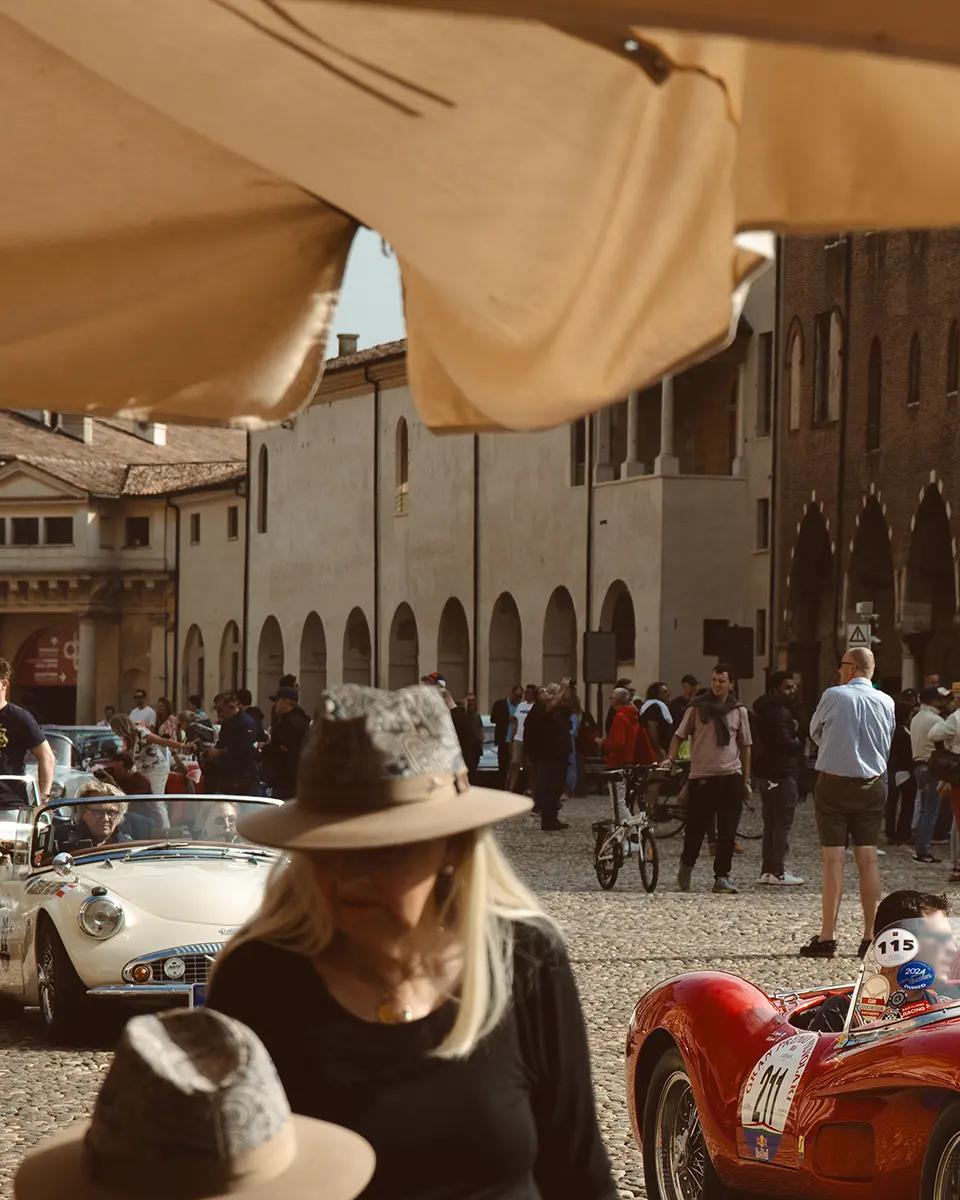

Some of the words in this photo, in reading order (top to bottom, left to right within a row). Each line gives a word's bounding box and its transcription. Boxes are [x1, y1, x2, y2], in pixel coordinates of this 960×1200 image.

[878, 939, 914, 955] 115
[905, 967, 926, 976] 2024
[751, 1064, 789, 1126] 211
